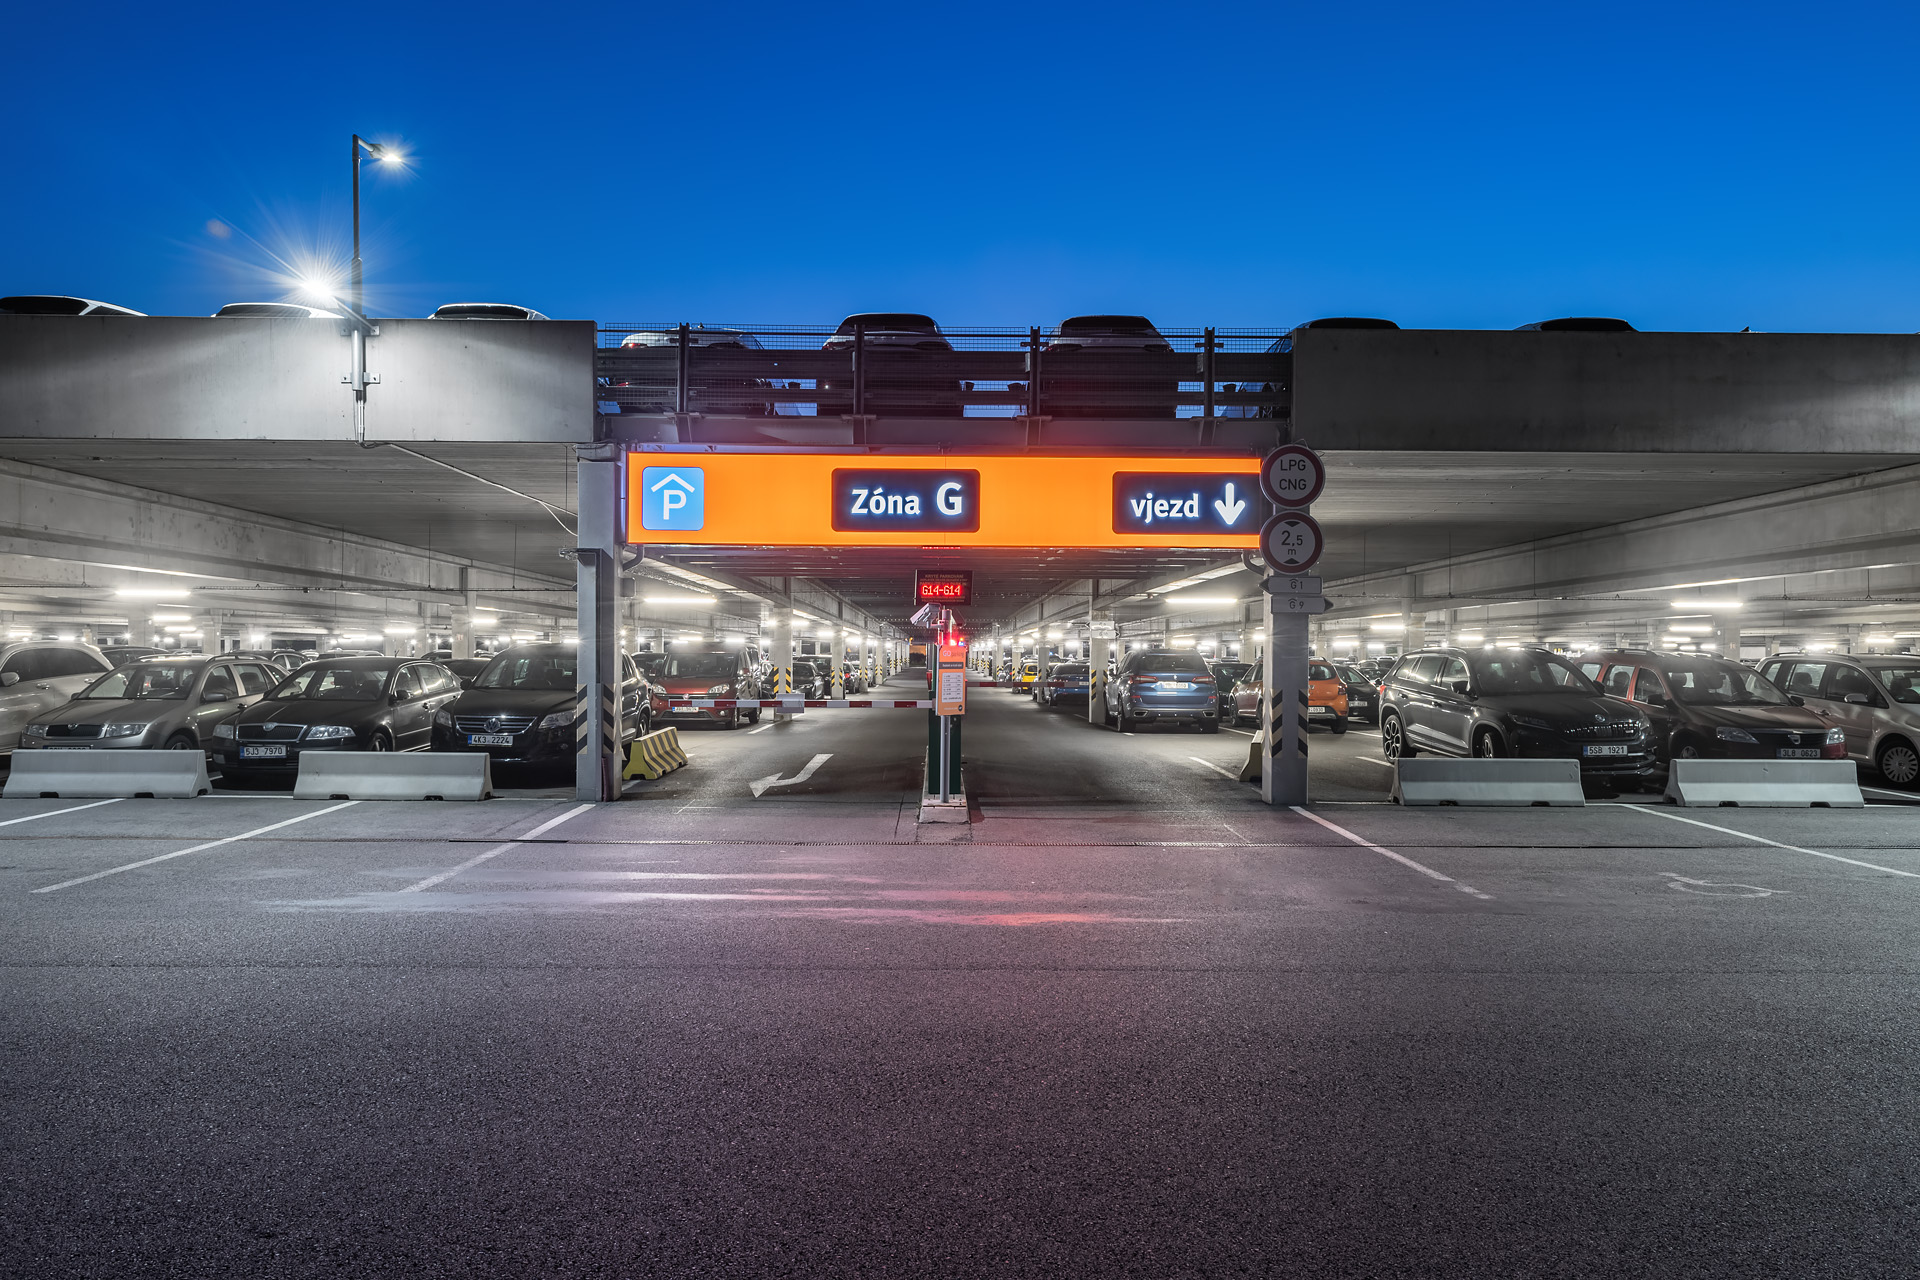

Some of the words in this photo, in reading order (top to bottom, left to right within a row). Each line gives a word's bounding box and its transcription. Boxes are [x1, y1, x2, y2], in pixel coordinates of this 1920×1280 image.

[1280, 459, 1306, 471] LPG
[1279, 478, 1307, 490] CNG
[663, 489, 687, 520] P
[851, 487, 921, 515] Zóna
[936, 482, 963, 515] G
[1130, 492, 1199, 524] vjezd
[1281, 530, 1304, 547] 2,5
[1608, 746, 1625, 754] 1921
